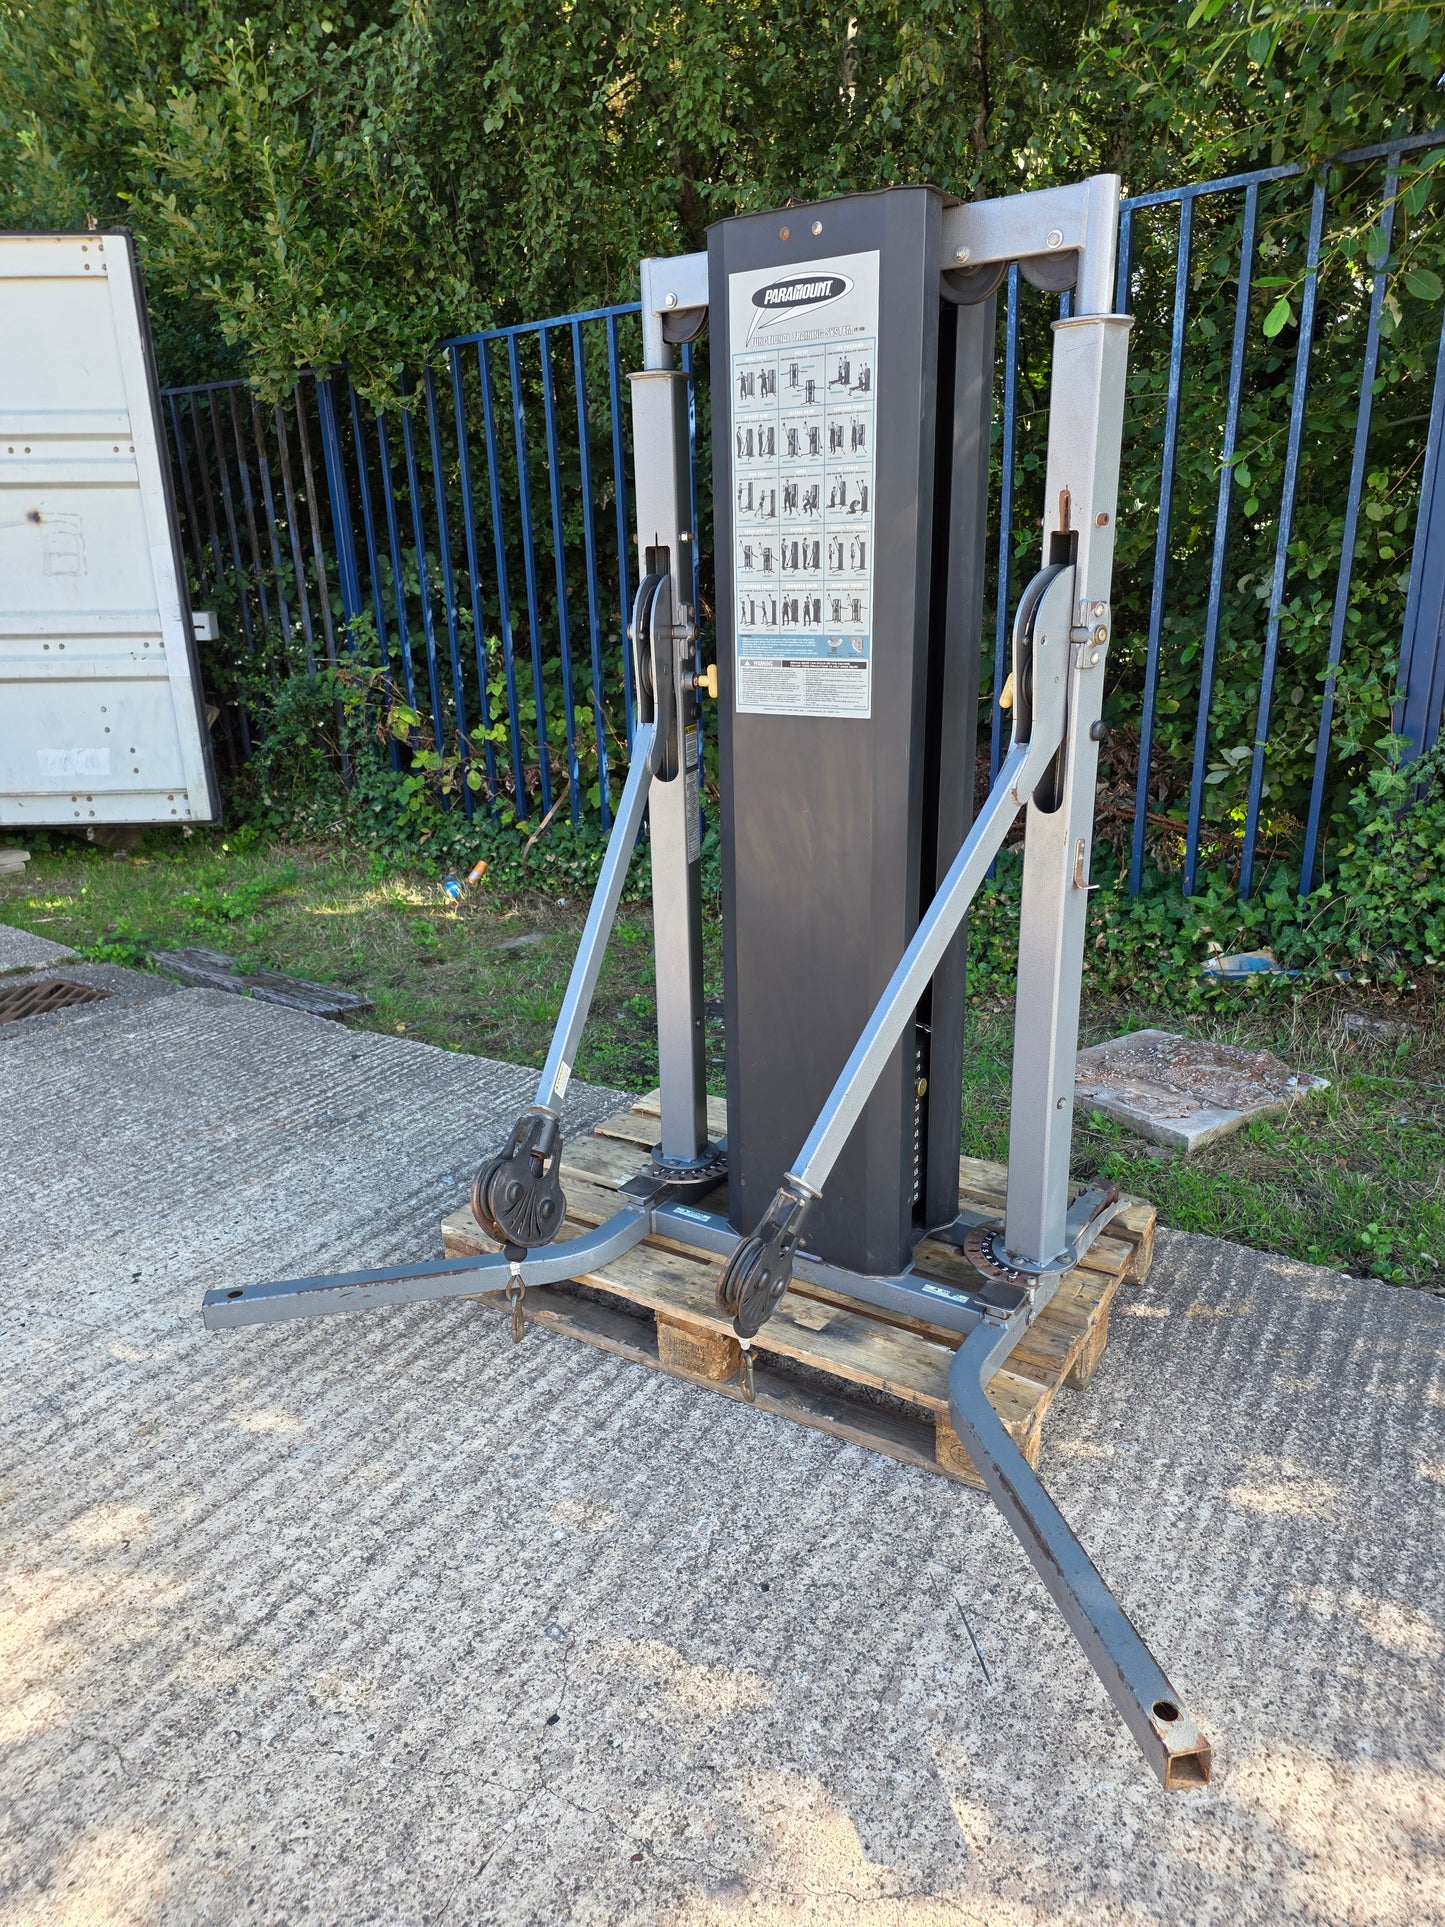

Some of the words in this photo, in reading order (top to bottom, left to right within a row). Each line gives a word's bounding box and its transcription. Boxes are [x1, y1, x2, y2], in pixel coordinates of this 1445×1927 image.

[764, 280, 833, 305] PARAMOUNT
[751, 333, 790, 347] FUNCTIONAL
[792, 329, 823, 342] TRAINING
[825, 325, 853, 338] SYSTEM
